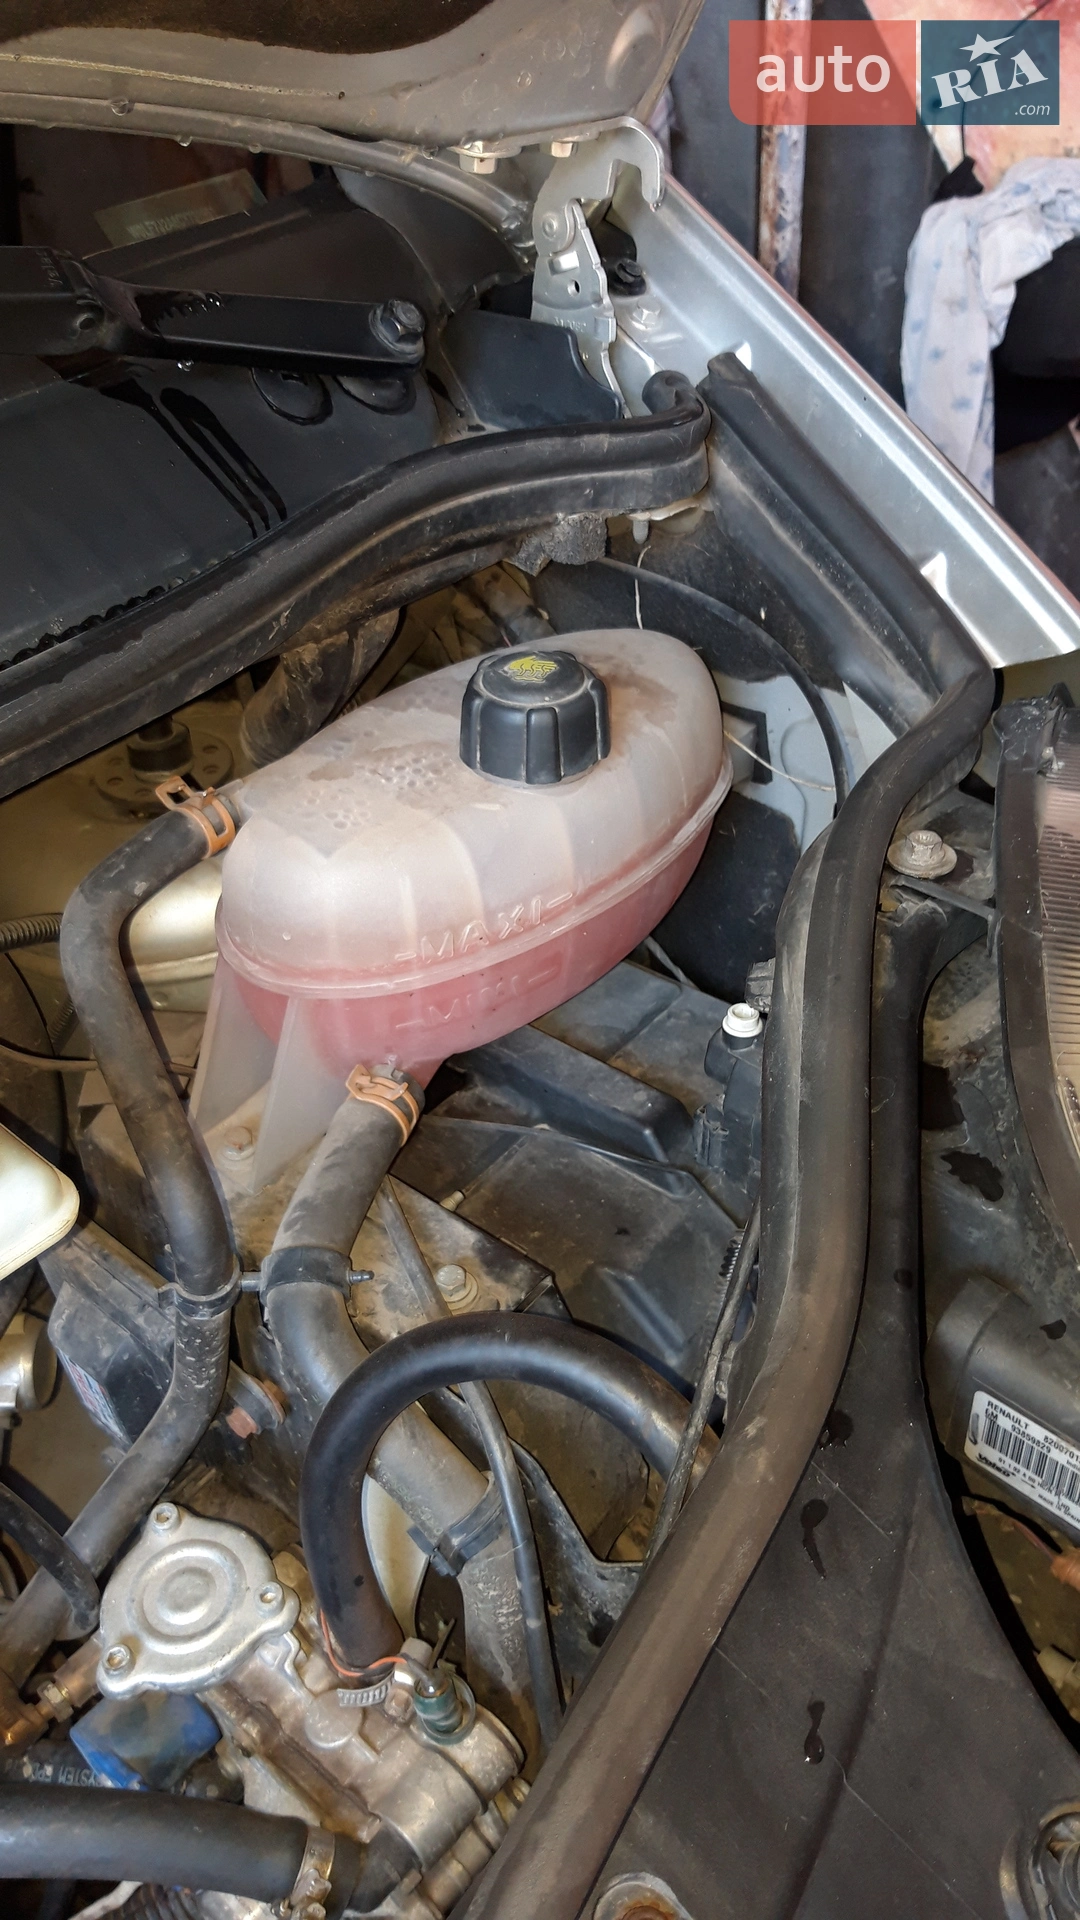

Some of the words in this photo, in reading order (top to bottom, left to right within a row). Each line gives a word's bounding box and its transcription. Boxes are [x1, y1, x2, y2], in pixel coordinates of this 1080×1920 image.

[421, 895, 542, 964] MAXI
[987, 1400, 1030, 1430] RENAULT
[1043, 1434, 1080, 1464] 8200701
[977, 1452, 1010, 1478] Valeo
